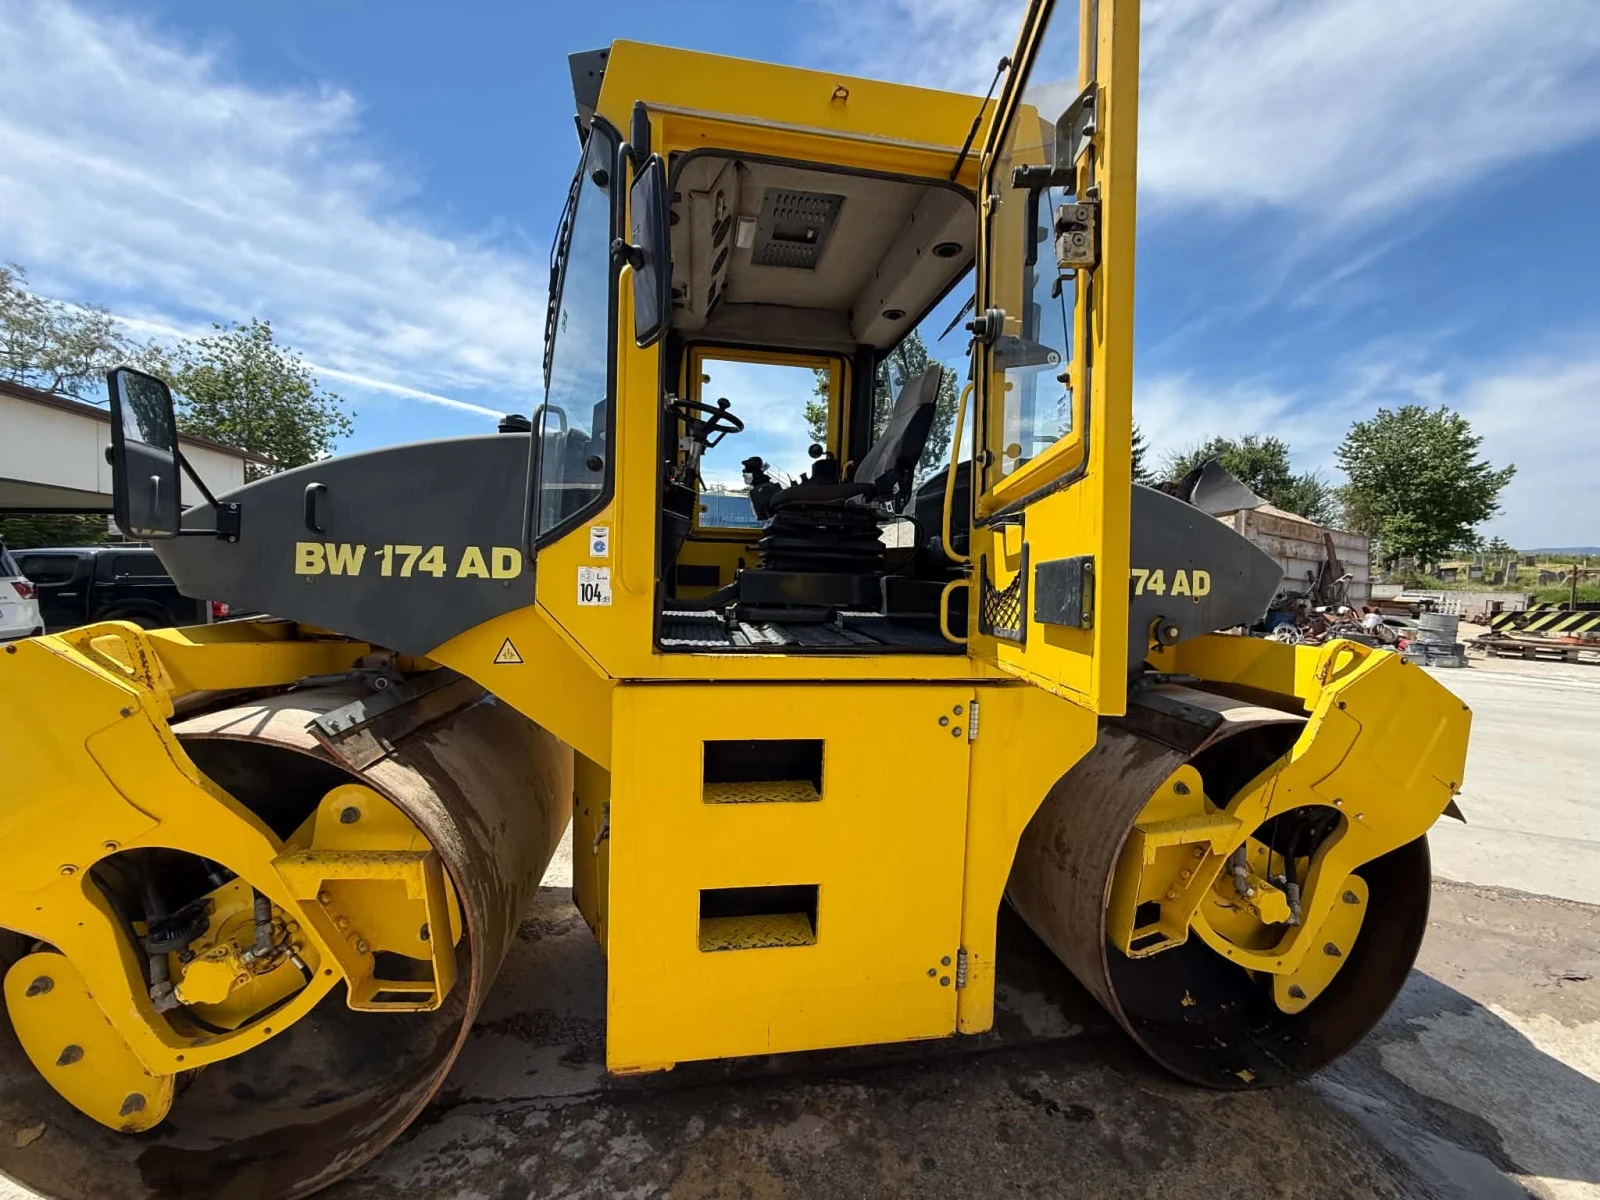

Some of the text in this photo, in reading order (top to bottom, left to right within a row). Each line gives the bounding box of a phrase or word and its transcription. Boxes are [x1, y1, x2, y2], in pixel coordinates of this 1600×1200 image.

[295, 542, 522, 579] BW 174 AD
[580, 583, 602, 602] 104
[1129, 568, 1211, 596] 74 AD
